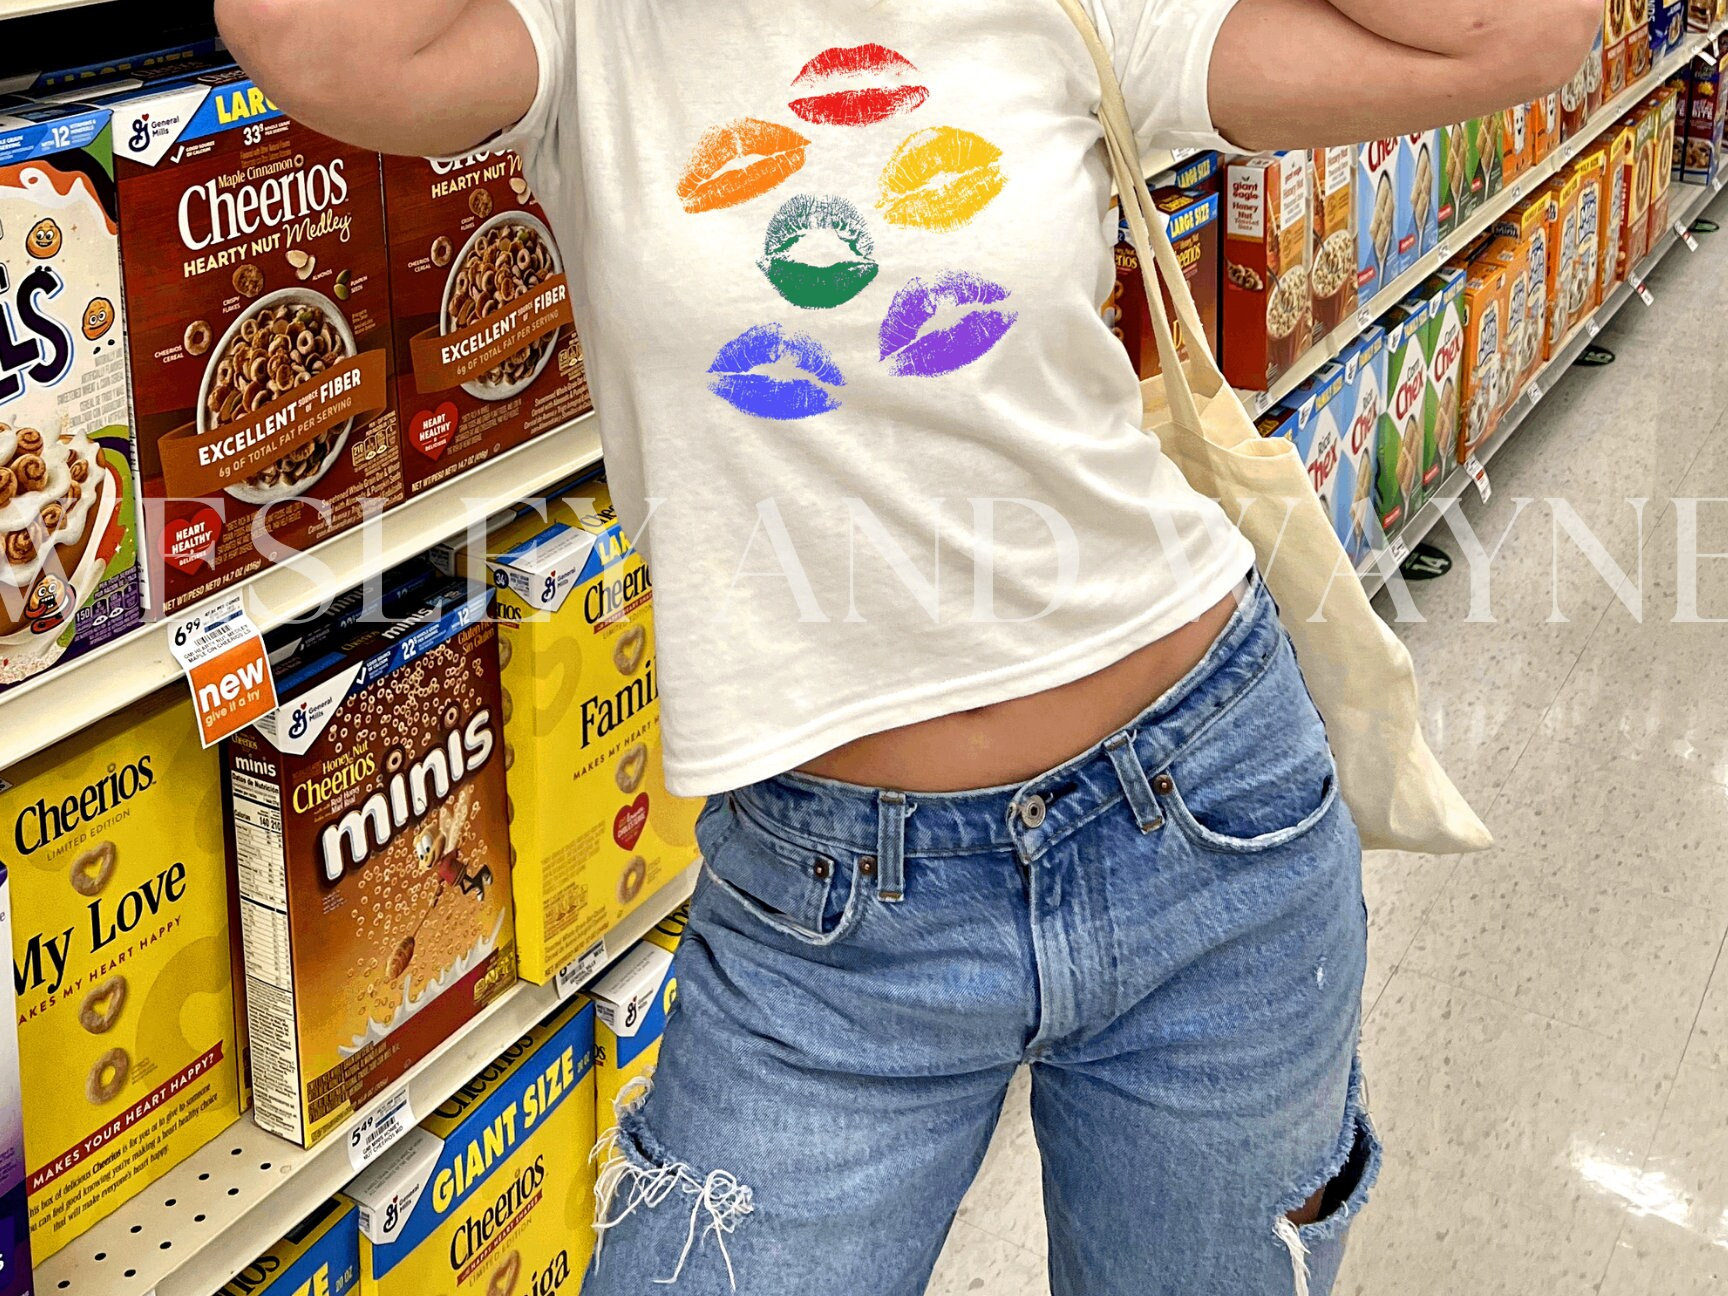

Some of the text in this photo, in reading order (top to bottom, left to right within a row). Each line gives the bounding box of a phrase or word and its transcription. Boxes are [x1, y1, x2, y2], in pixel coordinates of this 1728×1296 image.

[151, 116, 180, 129] General
[152, 125, 169, 138] Mills
[217, 160, 293, 191] Maple Cinnamon
[431, 162, 506, 199] HEARTY NUT
[1177, 159, 1211, 189] LARGE SIZE
[1232, 181, 1258, 194] giant
[178, 159, 348, 251] Cheerios
[1170, 203, 1210, 239] LARGE SIZE
[1232, 201, 1259, 215] Honey
[1237, 211, 1253, 220] Nut
[184, 209, 352, 278] HEARTY NUT Medley
[312, 269, 333, 282] ALMONDS
[154, 345, 182, 359] CHEERIOS
[162, 352, 184, 364] CEREAL
[1406, 358, 1420, 382] Corn
[1434, 334, 1462, 383] Chex
[1396, 367, 1425, 421] Chex
[419, 423, 452, 442] HEALTHY
[422, 414, 446, 430] HEART
[1351, 399, 1378, 455] Chex
[172, 532, 211, 556] HEALTHY
[176, 522, 205, 541] HEART
[199, 657, 264, 714] new
[205, 690, 261, 727] give it a try
[308, 696, 333, 715] General
[309, 709, 324, 723] Mills
[236, 752, 276, 778] minis
[322, 739, 369, 776] Honey Nut
[572, 721, 652, 781] MAKES MY HEART
[292, 751, 375, 815] Cheerios
[322, 710, 495, 881] minis
[15, 755, 155, 857] Cheerios
[46, 808, 131, 863] LIMITED EDITION
[32, 1150, 80, 1190] MAKES
[84, 1120, 121, 1153] YOUR
[125, 1088, 168, 1126] HEART
[170, 1053, 216, 1093] HAPPY?
[432, 1102, 518, 1213] GIANT
[522, 1045, 575, 1130] SIZE
[38, 1212, 51, 1228] can
[52, 1203, 65, 1218] feel
[65, 1191, 82, 1212] good
[82, 1172, 111, 1200] knowing
[112, 1159, 132, 1181] you're
[132, 1140, 156, 1164] making
[162, 1122, 178, 1141] heart
[178, 1107, 200, 1131] healthy
[200, 1092, 219, 1113] choice
[450, 1154, 545, 1271] Cheerios
[469, 1217, 532, 1288] LIMITED EDITION
